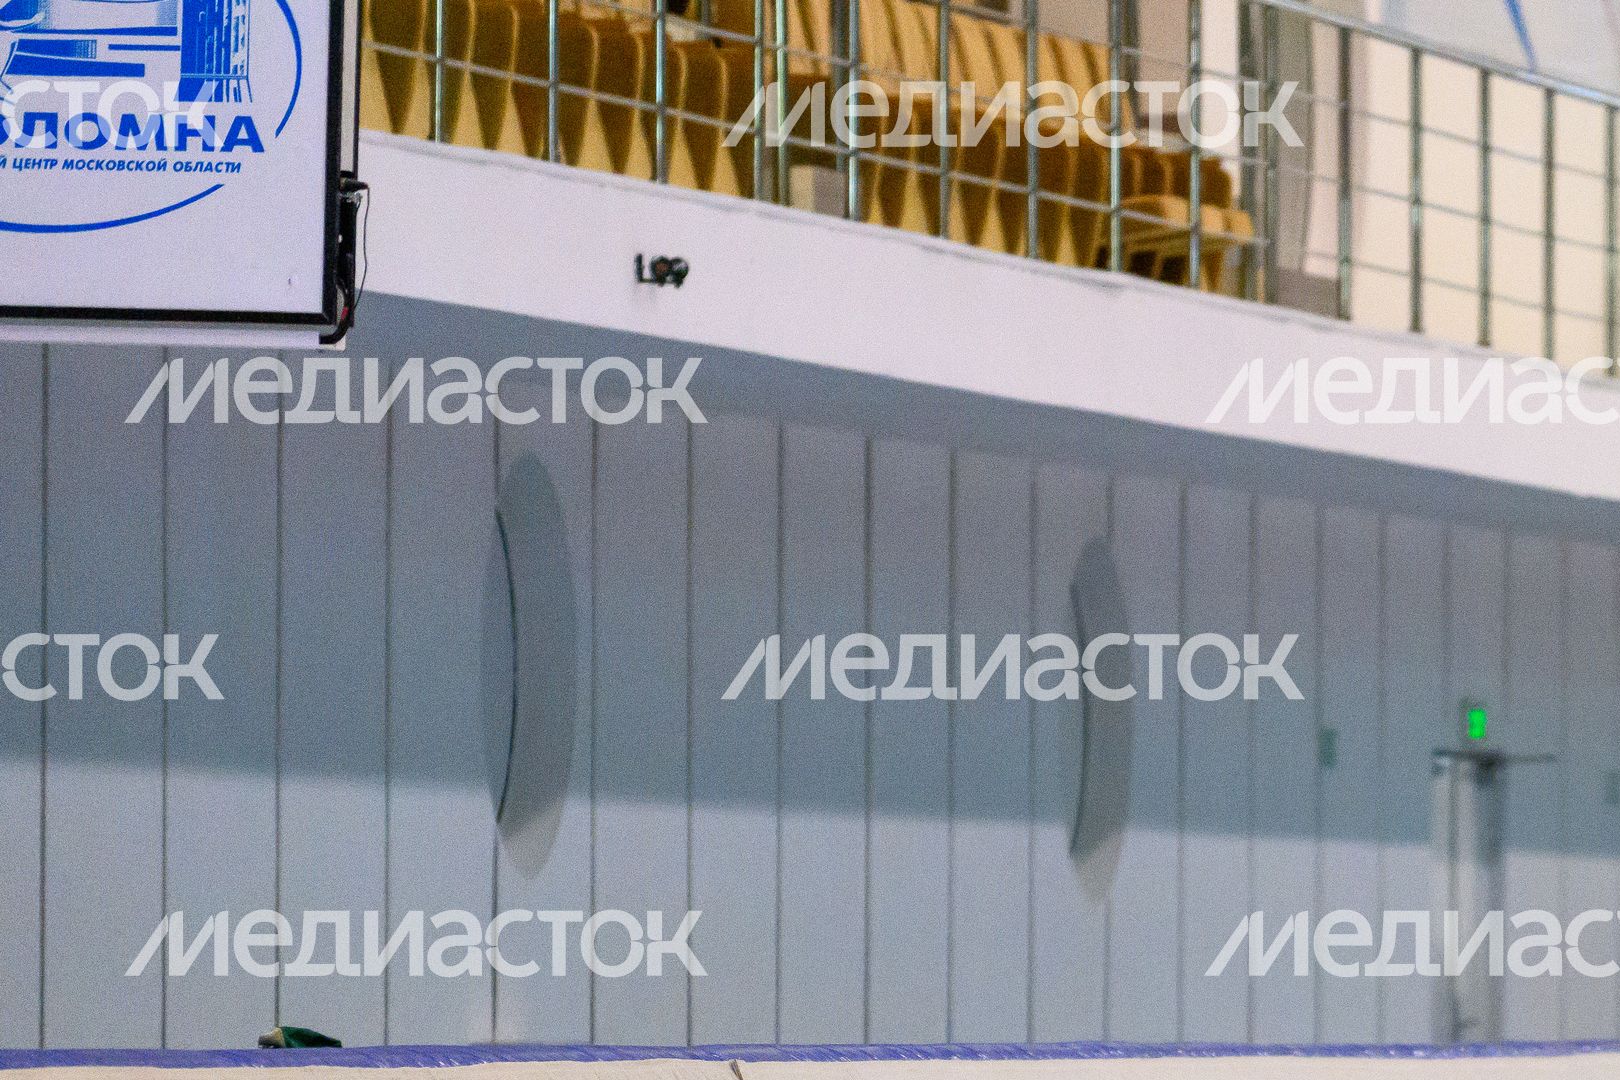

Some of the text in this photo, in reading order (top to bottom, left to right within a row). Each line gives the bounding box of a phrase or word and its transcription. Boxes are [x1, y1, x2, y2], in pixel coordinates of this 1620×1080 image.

[0, 112, 265, 153] ЛОМНА
[12, 157, 58, 171] ЦЕНТР
[62, 157, 168, 173] МОСКОВСКОЙ
[173, 161, 242, 174] ОБЛАСТИ
